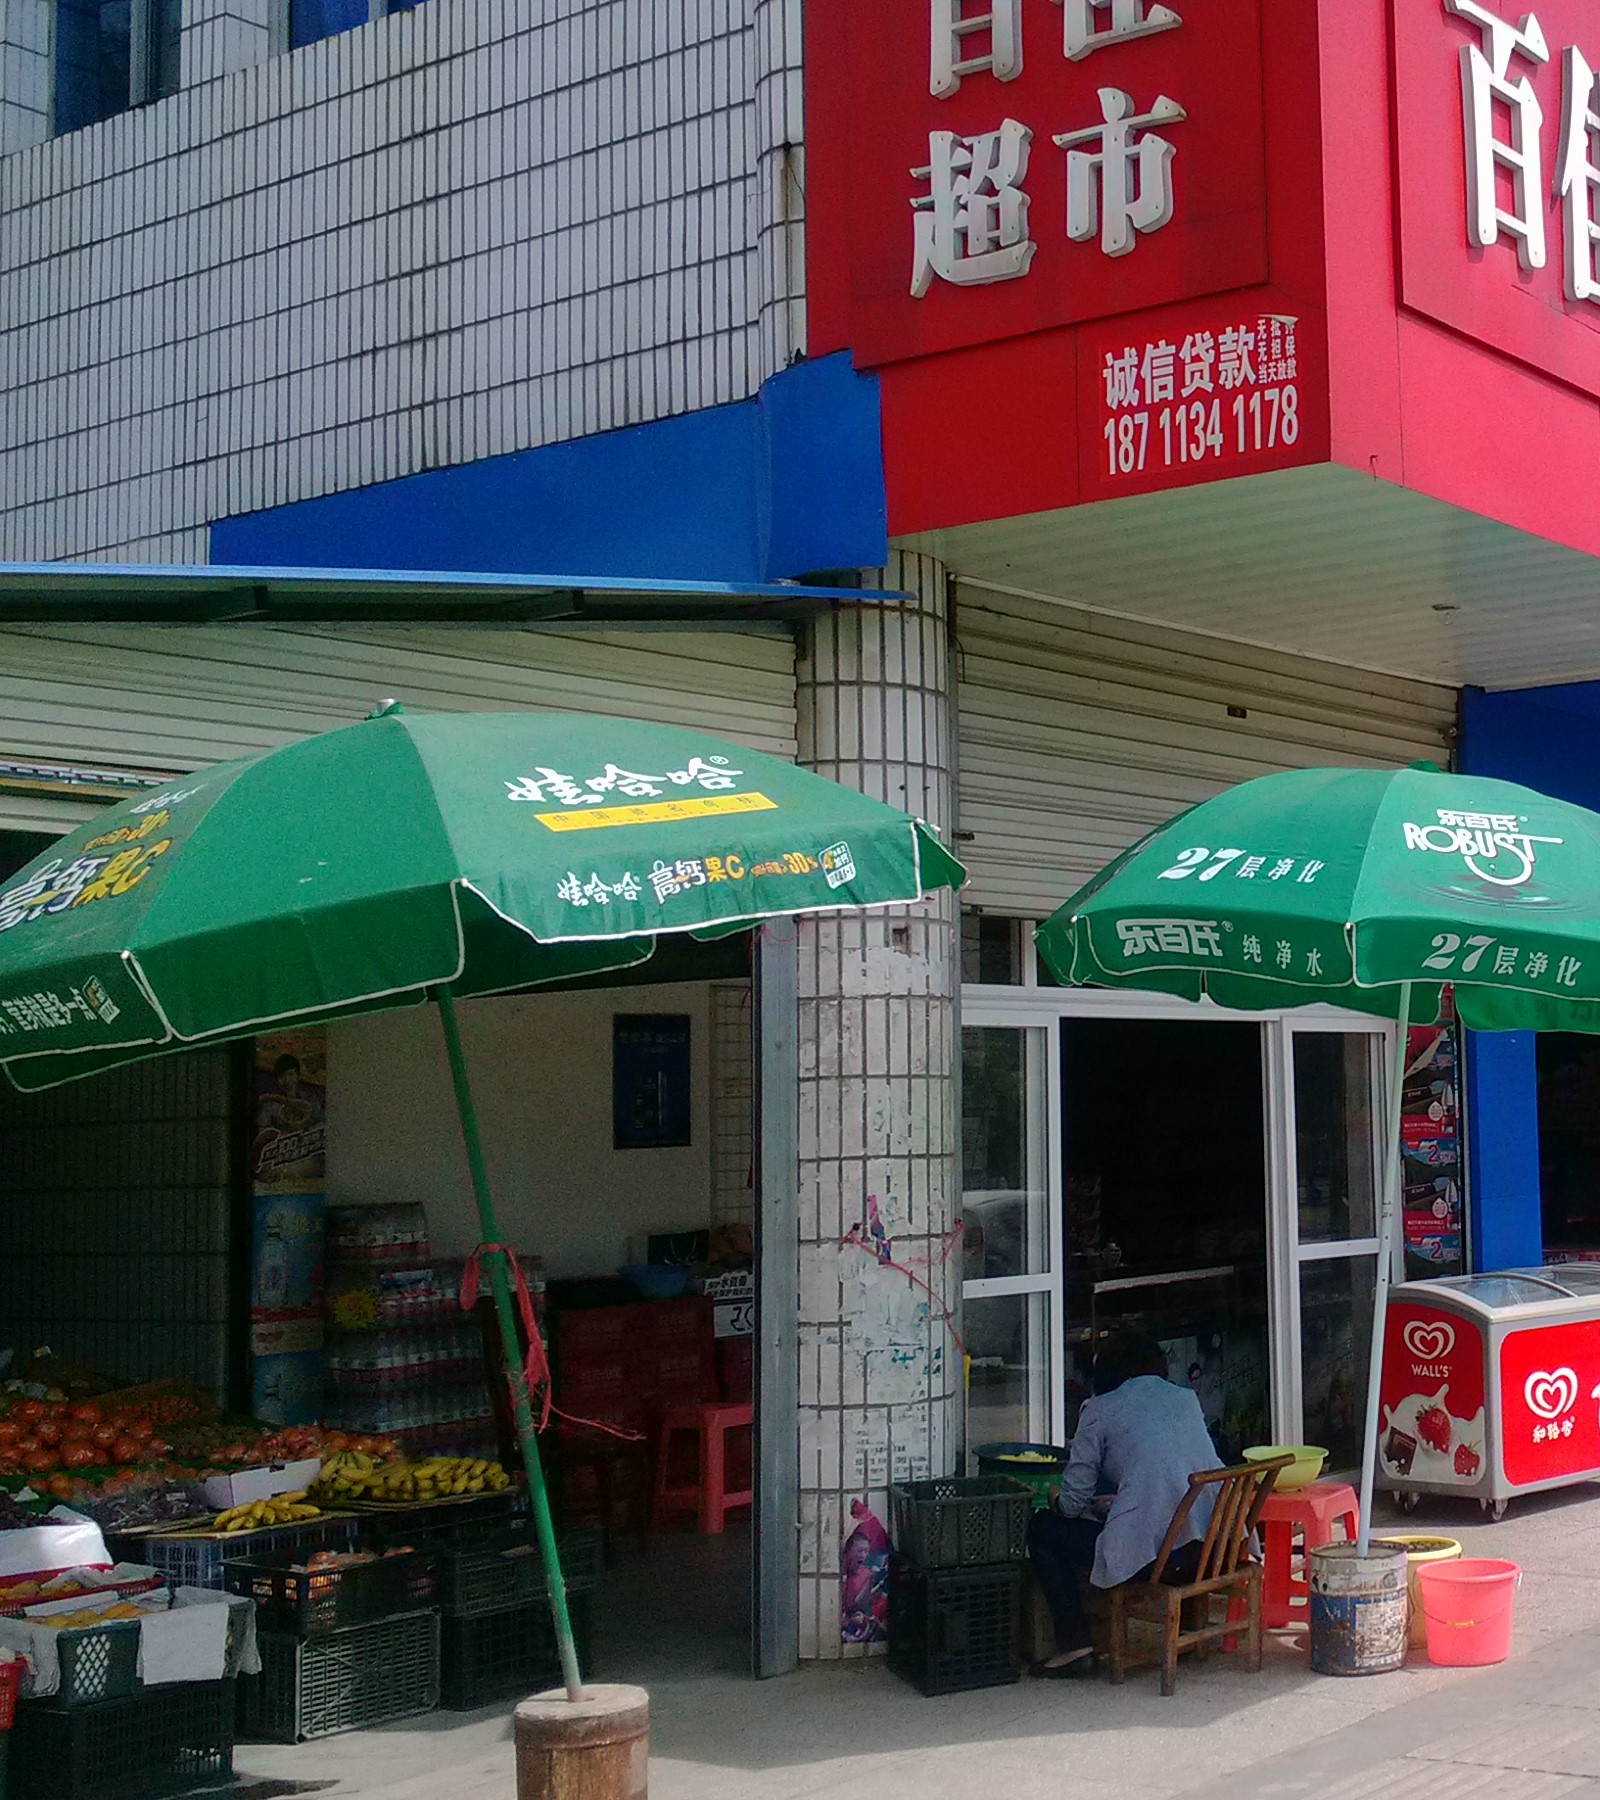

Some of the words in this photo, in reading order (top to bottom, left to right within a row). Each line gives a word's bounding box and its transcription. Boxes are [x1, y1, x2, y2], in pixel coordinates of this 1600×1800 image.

[909, 87, 1187, 298] 超市
[1103, 324, 1257, 410] 诚信贷款
[1257, 336, 1296, 362] 无担保
[1257, 357, 1298, 385] 当天放款
[1104, 411, 1149, 475] 187
[1159, 398, 1224, 466] 1134
[1232, 384, 1299, 453] 1178
[504, 756, 744, 805] 娃哈哈
[1437, 809, 1519, 832] 乐百氏
[1157, 847, 1326, 883] 27层净化
[1403, 822, 1564, 886] ROBUST
[556, 871, 643, 907] 娃哈哈
[1116, 918, 1223, 957] 乐百氏
[1243, 933, 1323, 977] 纯净水
[1421, 932, 1582, 987] 27层净化
[1411, 1363, 1449, 1378] WALL'S
[1531, 1420, 1575, 1444] 和路雪
